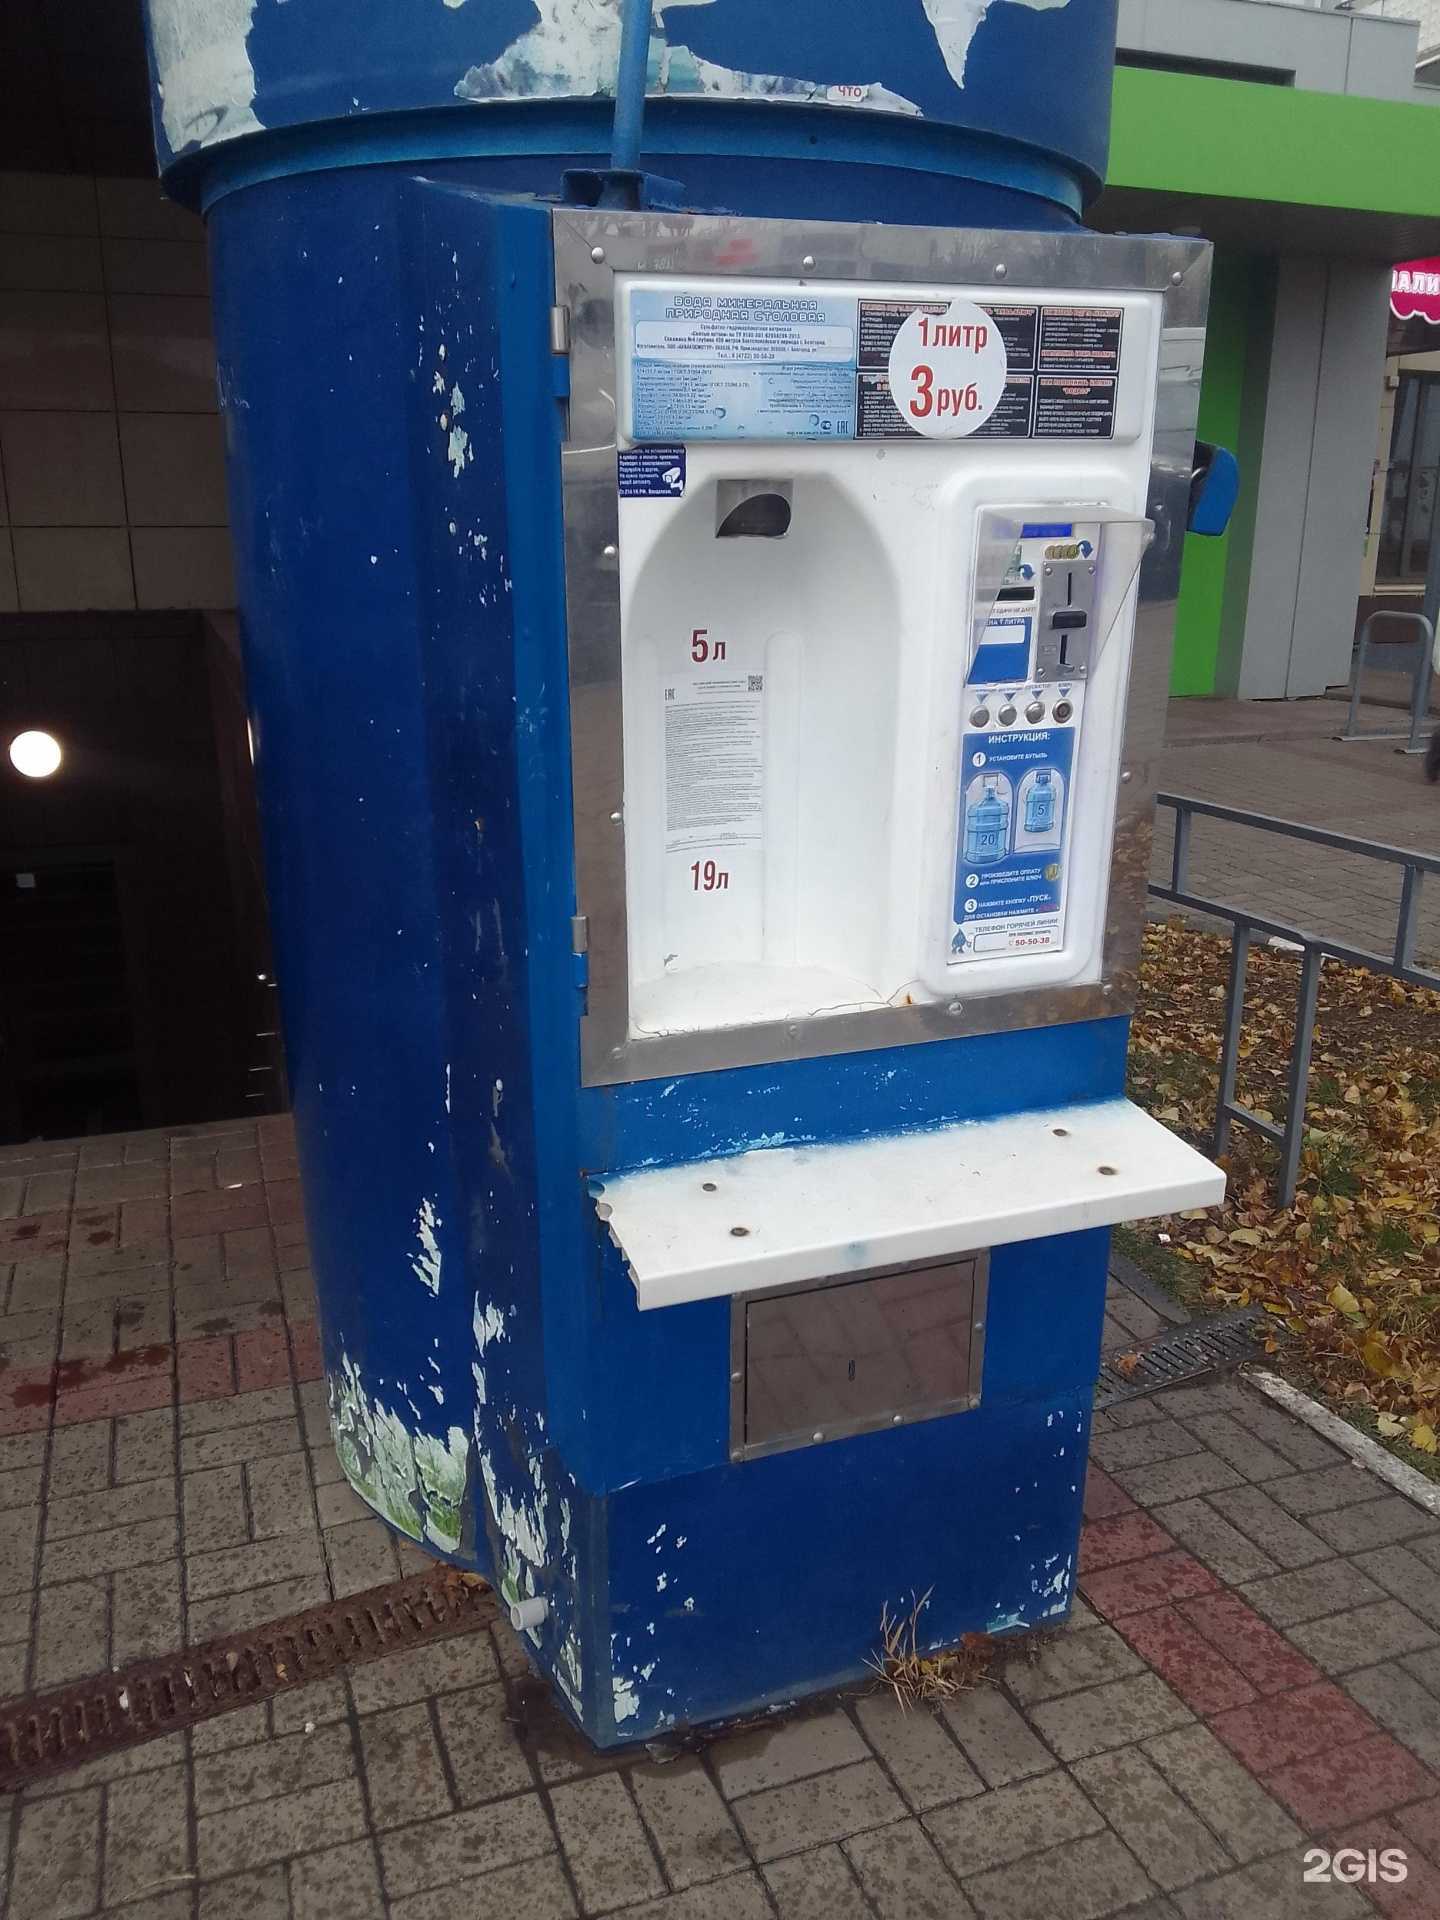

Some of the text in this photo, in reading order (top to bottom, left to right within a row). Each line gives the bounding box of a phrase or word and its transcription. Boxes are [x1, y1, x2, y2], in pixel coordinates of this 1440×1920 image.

[838, 85, 862, 97] ЧТО
[1391, 270, 1440, 295] АЛИ
[674, 295, 817, 310] ВОДА МИНЕРАЛЬНАЯ
[665, 307, 826, 322] ПРИРОДНАЯ СТОЛОВАЯ
[909, 364, 934, 417] 3
[936, 382, 982, 417] руб.
[691, 629, 726, 662] 5 л
[988, 731, 1051, 744] ИНСТРУКЦИЯ:
[988, 754, 1024, 762] УСТАНОВИТЕ
[1037, 804, 1045, 815] 5
[981, 834, 995, 845] 20
[975, 923, 1006, 933] ТЕЛЕФОН
[1006, 921, 1036, 930] ГОРЯЧЕЙ
